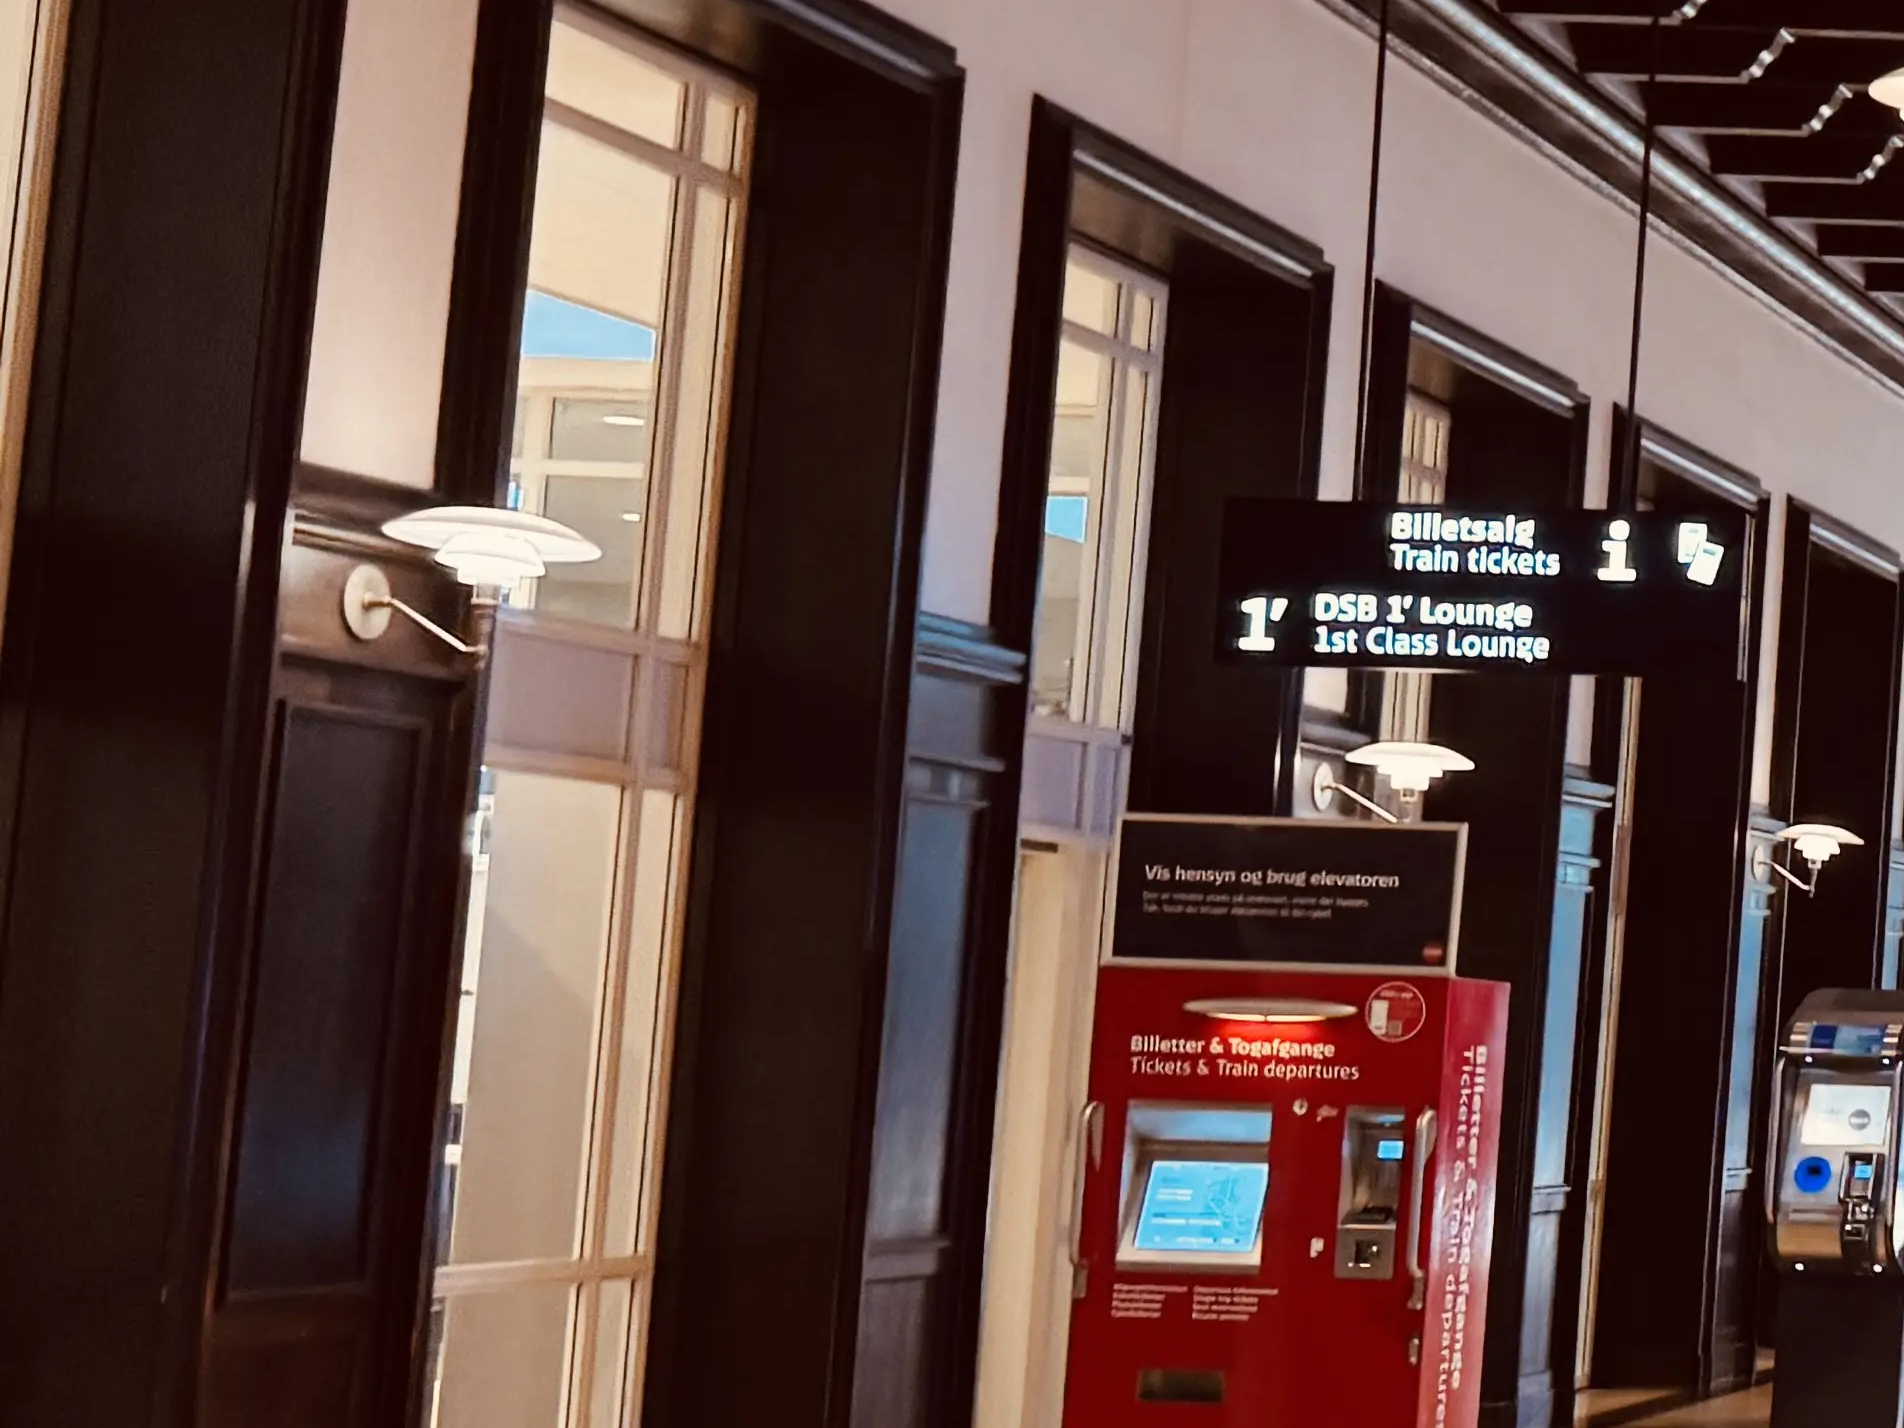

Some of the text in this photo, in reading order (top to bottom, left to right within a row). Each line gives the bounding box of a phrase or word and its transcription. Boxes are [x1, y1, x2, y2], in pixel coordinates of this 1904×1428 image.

[1390, 511, 1536, 549] Billetsalg
[1390, 543, 1561, 577] Train tickets
[1314, 592, 1378, 623] DSB
[1419, 596, 1534, 632] Lounge
[1314, 625, 1550, 663] 1st Class Lounge
[1145, 864, 1400, 889] Vis hensyn og brug elevatoren
[1130, 1034, 1336, 1059] Billetter & Togafgange
[1130, 1055, 1360, 1082] Tickets & Train departures
